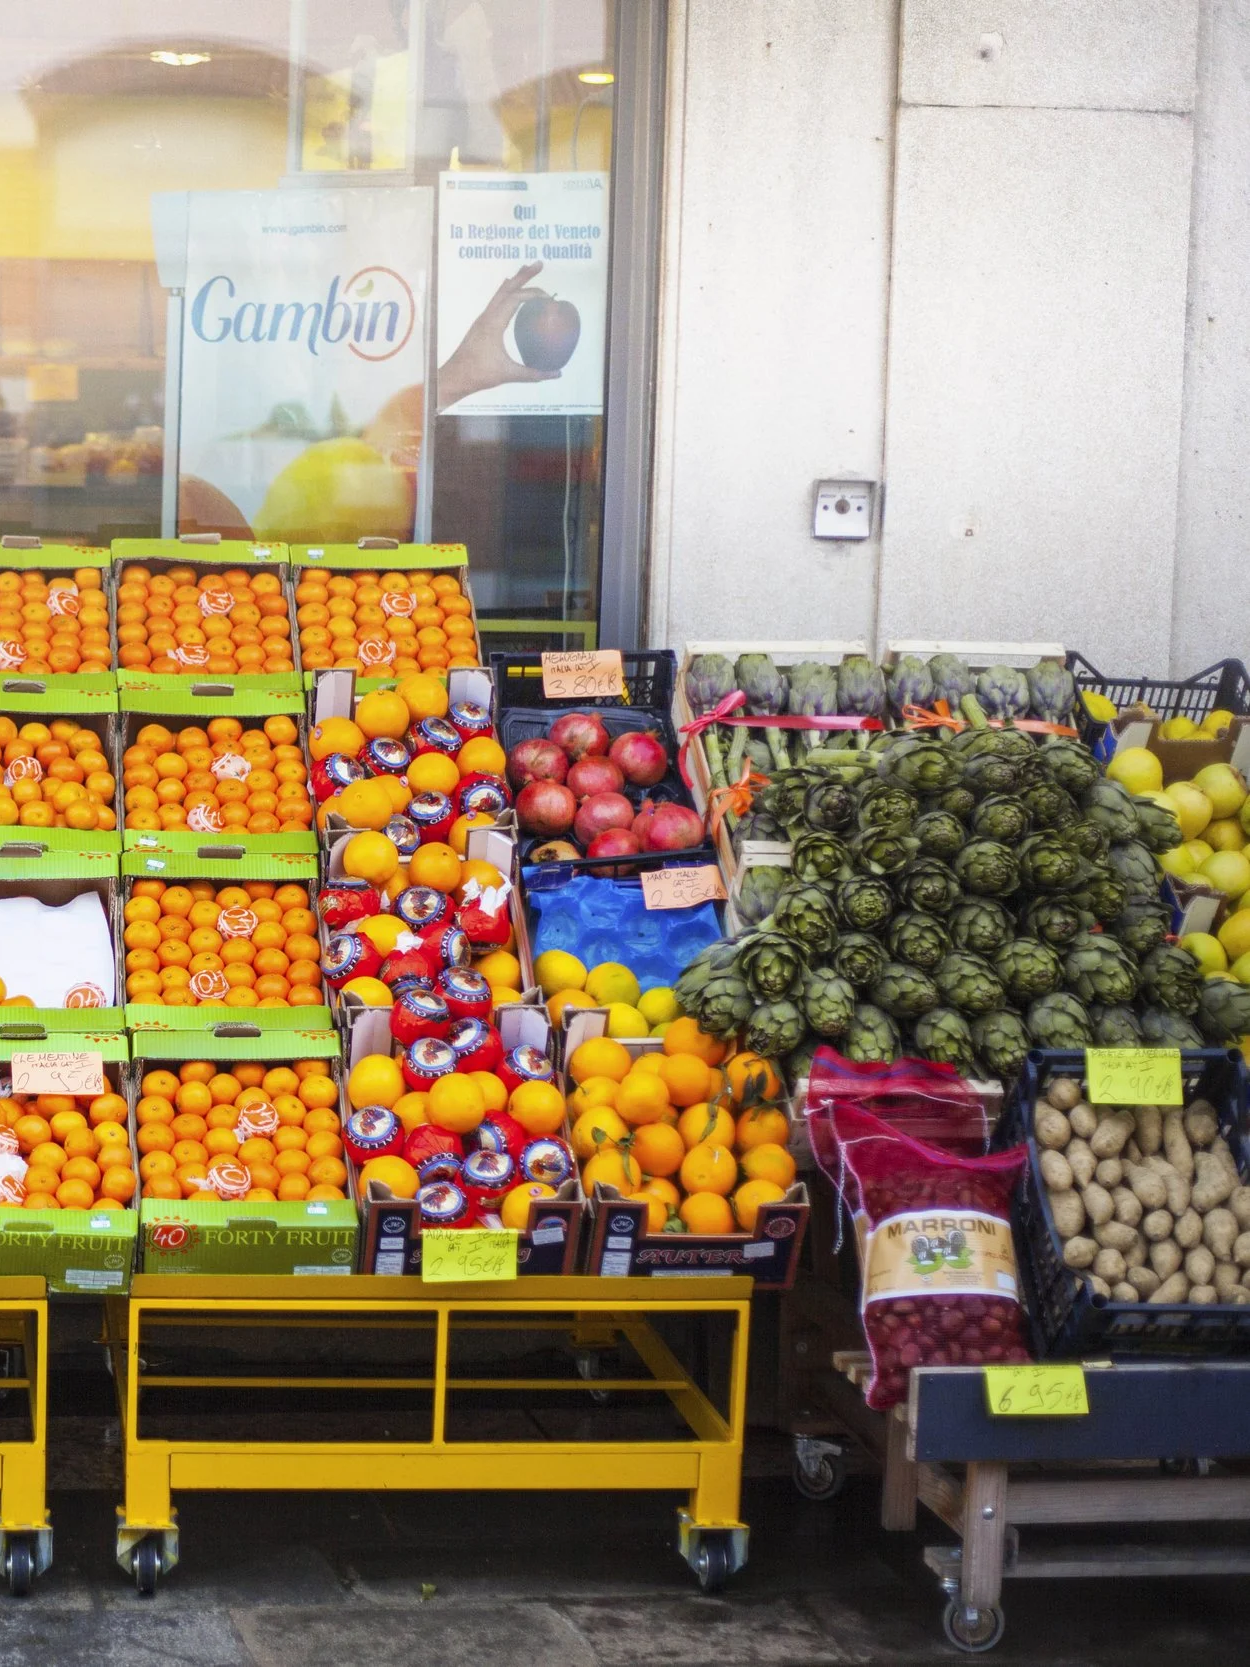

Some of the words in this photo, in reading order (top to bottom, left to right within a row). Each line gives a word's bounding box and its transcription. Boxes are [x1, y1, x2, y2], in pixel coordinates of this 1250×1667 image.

[513, 204, 536, 221] Qui
[450, 224, 463, 240] la
[468, 224, 524, 242] Regione
[528, 224, 550, 240] del
[554, 225, 601, 240] Veneto
[458, 244, 520, 260] controlla
[524, 244, 538, 260] la
[542, 244, 592, 262] Qualità
[190, 274, 400, 357] Gambin
[153, 1228, 185, 1246] 40
[205, 1230, 280, 1245] FORTY
[287, 1230, 355, 1246] FRUIT
[888, 1217, 996, 1239] MARRONI
[59, 1235, 128, 1251] FRUIT
